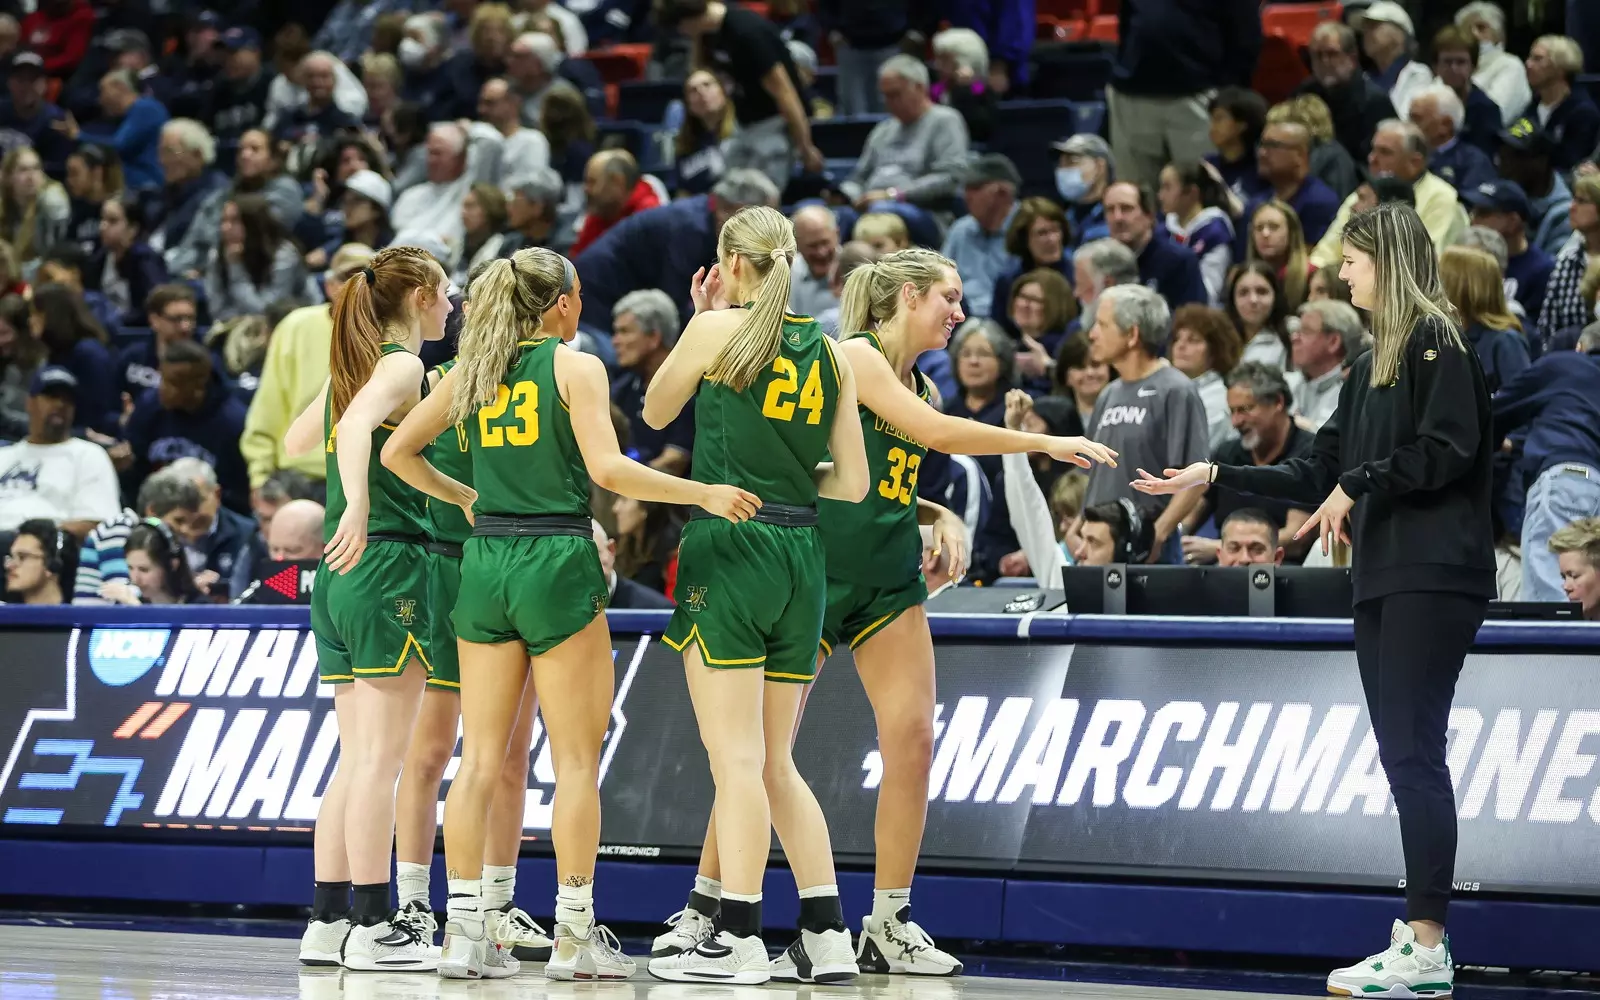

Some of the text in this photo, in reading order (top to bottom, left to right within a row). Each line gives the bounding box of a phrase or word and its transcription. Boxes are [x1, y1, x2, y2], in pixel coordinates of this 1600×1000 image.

[478, 380, 539, 448] 23
[762, 355, 824, 425] 24
[1098, 406, 1147, 430] CONN
[878, 446, 921, 506] 33
[862, 695, 1600, 826] MARCHMANE
[598, 845, 661, 857] AKTRONICS
